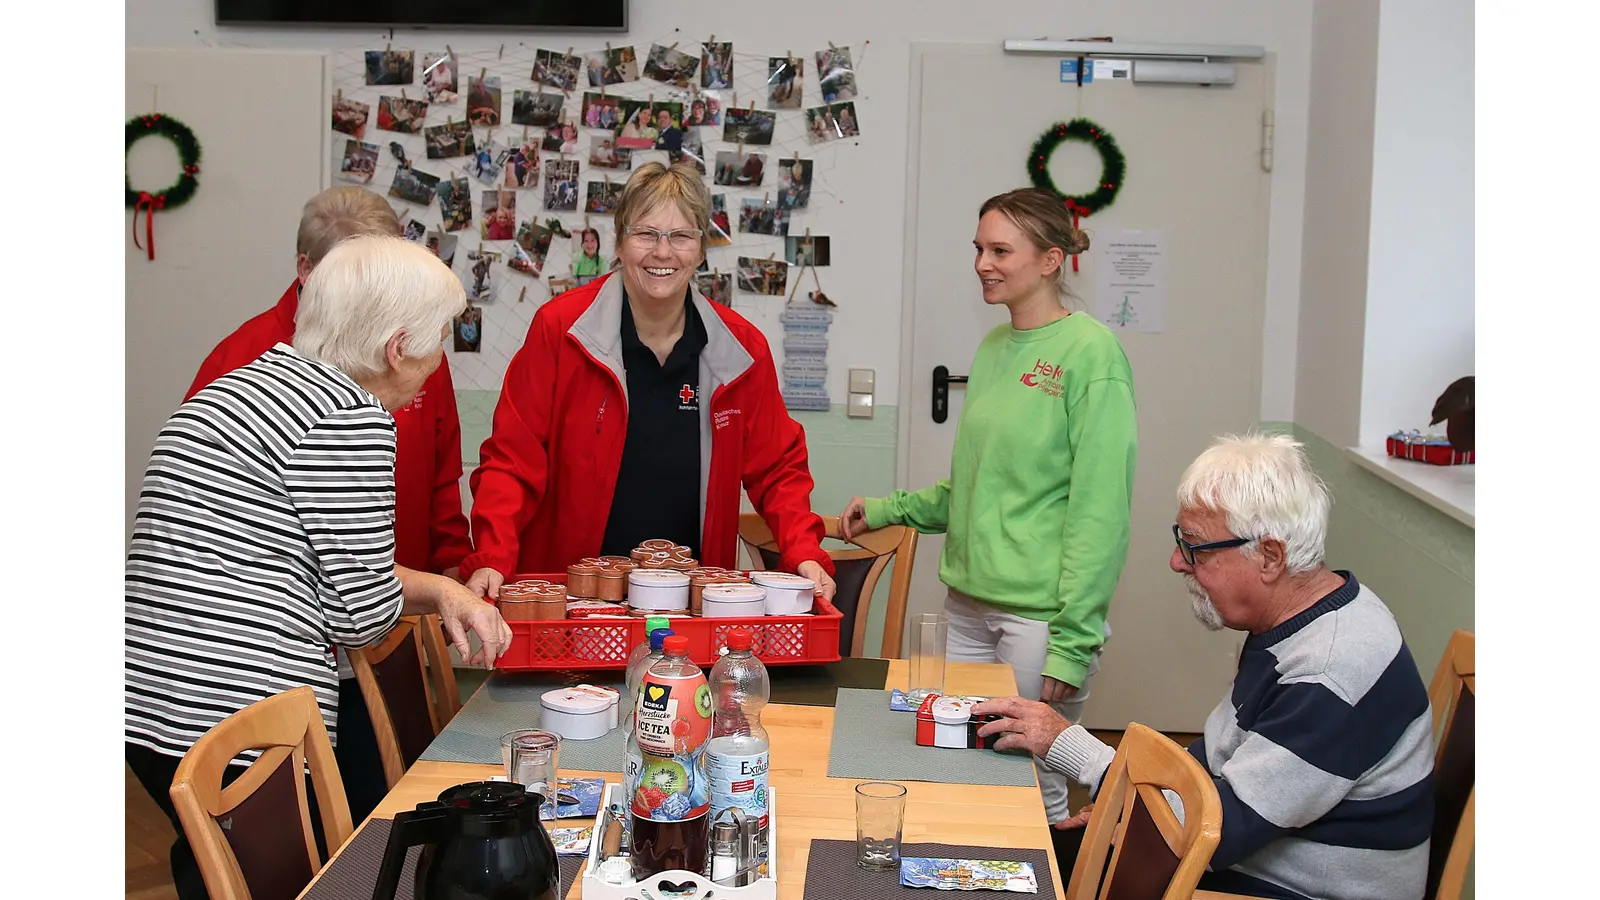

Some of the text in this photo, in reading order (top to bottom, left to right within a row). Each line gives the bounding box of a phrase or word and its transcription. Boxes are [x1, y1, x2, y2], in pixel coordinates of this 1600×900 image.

[644, 701, 664, 709] EDEKA
[638, 720, 670, 735] ICE TEA
